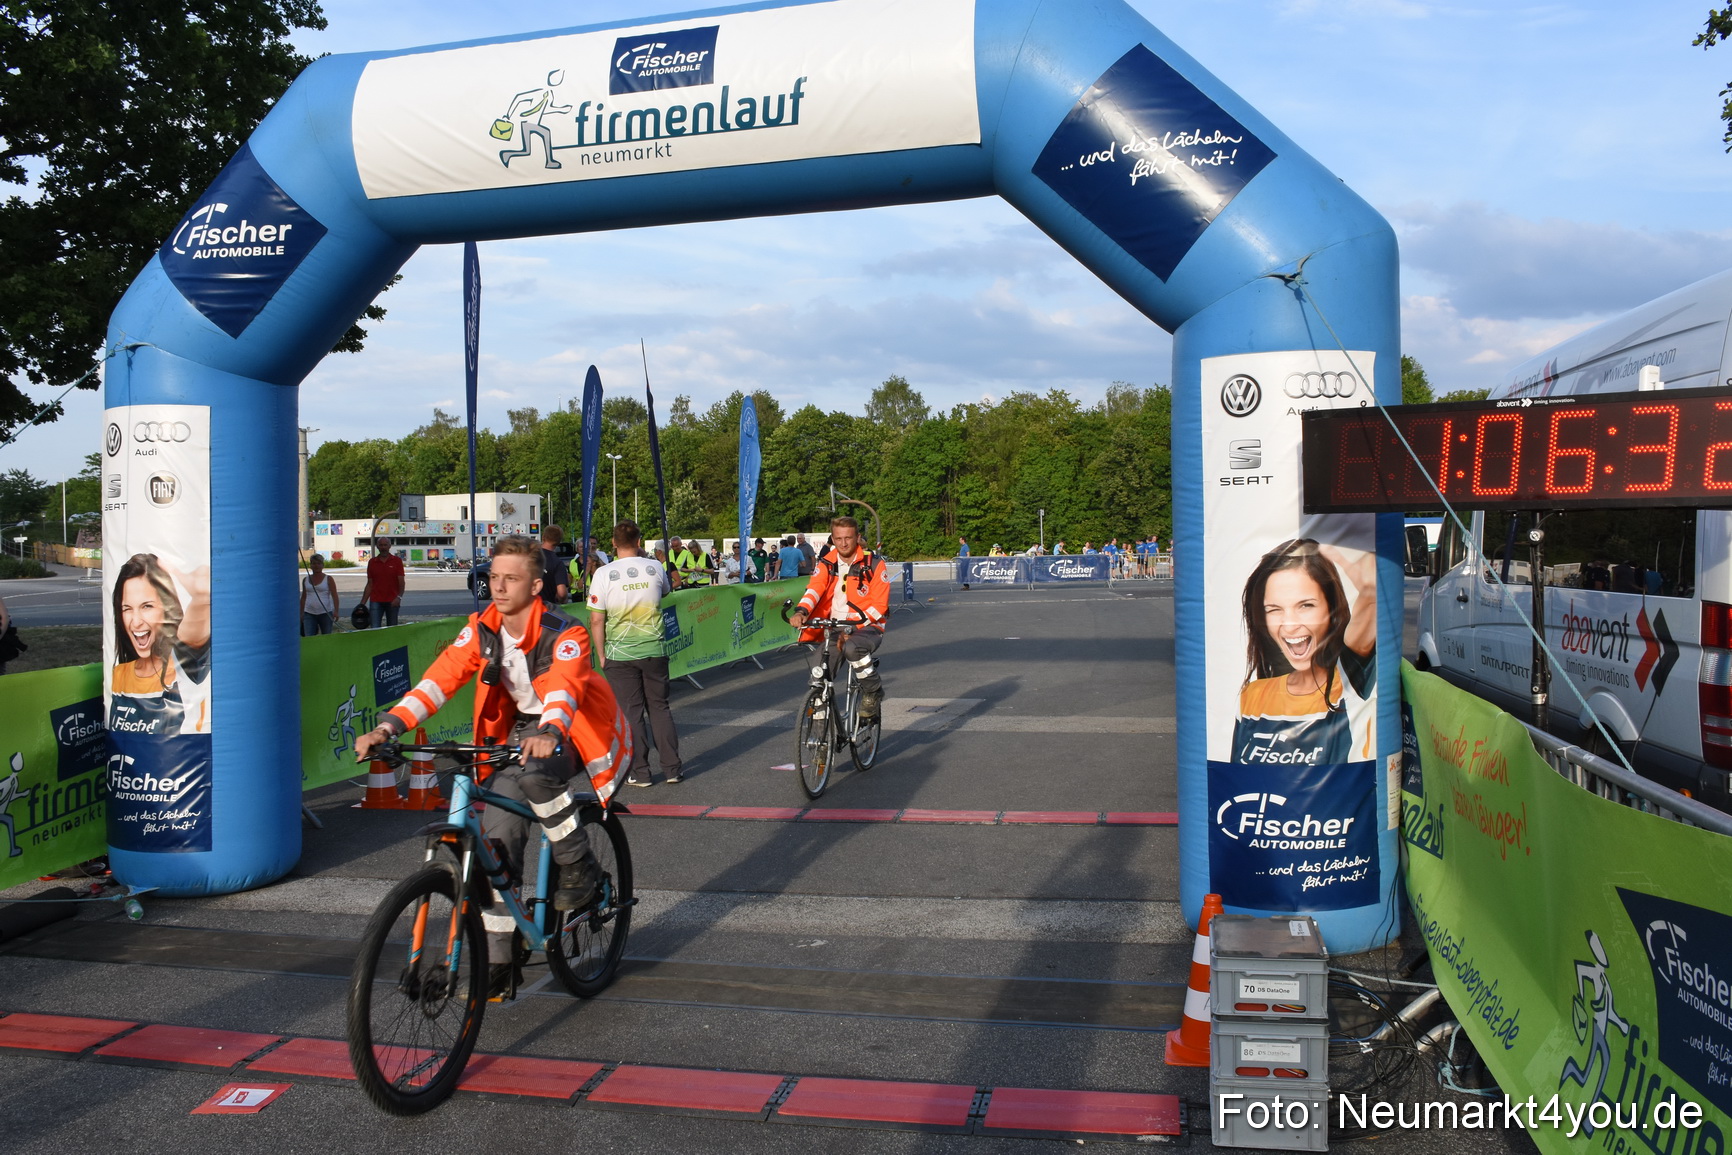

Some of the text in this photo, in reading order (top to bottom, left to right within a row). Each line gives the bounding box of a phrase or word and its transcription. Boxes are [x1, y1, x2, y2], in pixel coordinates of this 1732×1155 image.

[632, 51, 709, 70] Fischer
[638, 63, 702, 78] AUTOMOBILE
[574, 76, 808, 145] firmenlauf
[580, 142, 673, 166] neumarkt
[1079, 141, 1116, 168] und
[1121, 134, 1158, 155] das
[1162, 129, 1243, 150] Lächeln
[1129, 149, 1238, 186] fährt mit!
[186, 219, 293, 248] Fischer
[192, 245, 285, 260] AUTOMOBILE
[1496, 400, 1521, 408] abavent
[134, 448, 158, 457] Audi
[152, 481, 174, 498] FIAT
[1219, 475, 1274, 486] SEAT
[980, 567, 1019, 576] Fischer
[1057, 565, 1095, 575] Fischer
[622, 581, 649, 592] CREW
[1561, 598, 1631, 664] abavent
[380, 663, 404, 680] Fischer
[1481, 654, 1530, 679] DATASPORT
[1587, 660, 1630, 689] innovations
[1248, 744, 1324, 767] Fischer
[112, 768, 186, 793] Fischer
[115, 790, 178, 803] AUTOMOBILE
[32, 803, 103, 847] neumarkt
[124, 811, 138, 823] und
[140, 808, 158, 821] das
[171, 820, 197, 832] mit!
[1238, 813, 1355, 838] Fischer
[1248, 838, 1347, 850] AUTOMOBILE
[1268, 862, 1294, 876] und
[1297, 860, 1321, 873] das
[1323, 855, 1371, 871] Lächeln
[1301, 867, 1368, 892] fährt mit!
[1244, 985, 1256, 994] 70
[1677, 987, 1732, 1032] AUTOMOBILE
[1243, 1048, 1254, 1056] 86
[1690, 1034, 1704, 1054] und
[1705, 1035, 1719, 1060] das
